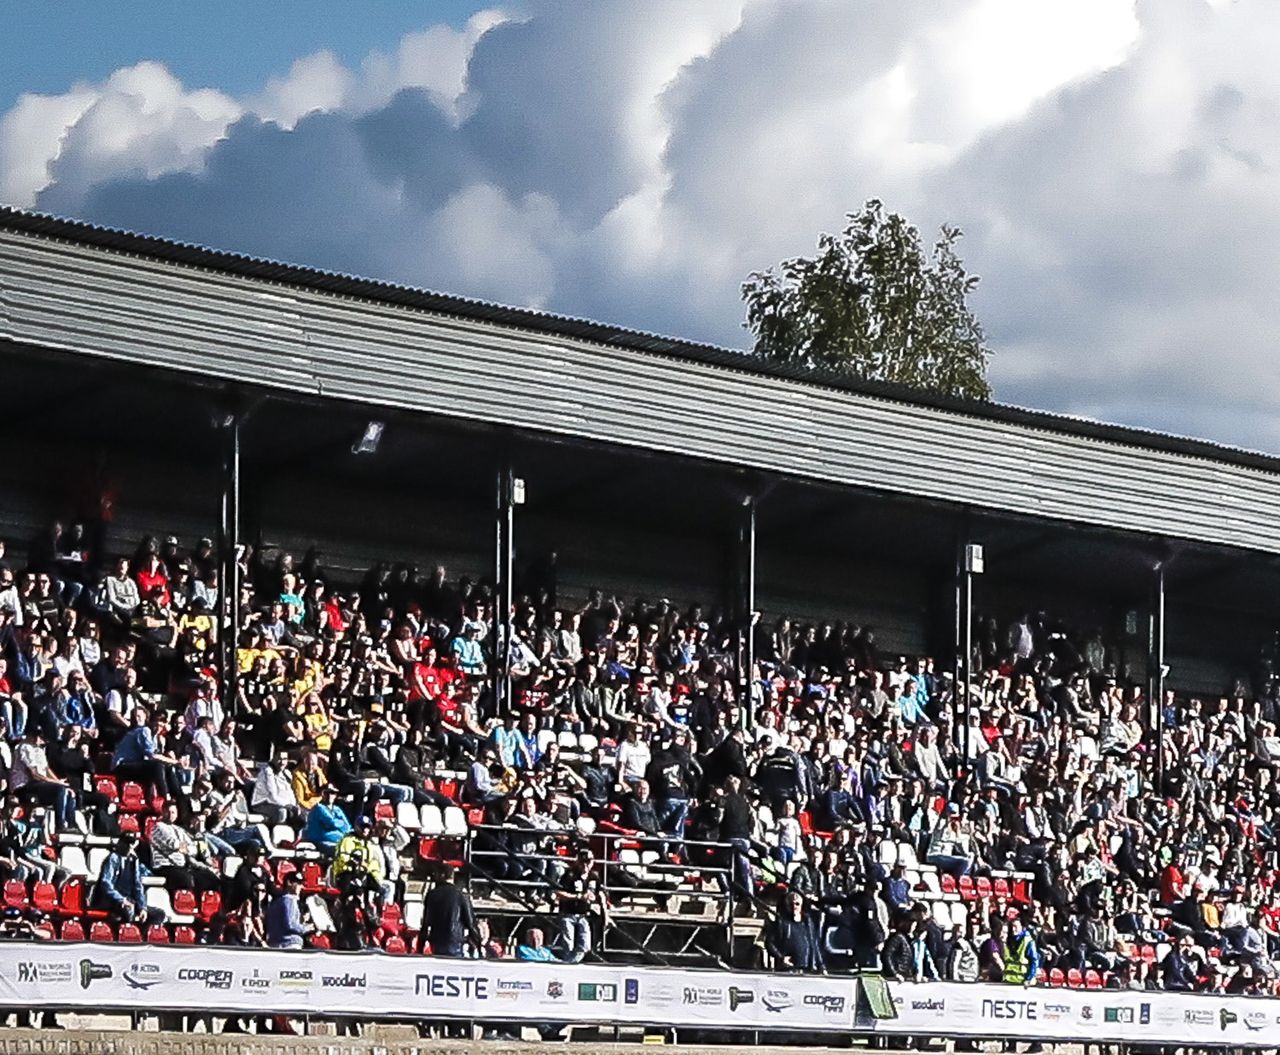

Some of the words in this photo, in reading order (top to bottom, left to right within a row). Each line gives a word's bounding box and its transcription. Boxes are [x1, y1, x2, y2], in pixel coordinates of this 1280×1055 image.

[178, 968, 233, 982] COOPER
[415, 974, 489, 999] NESTE
[803, 994, 846, 1006] COOPER
[981, 999, 1037, 1020] NESTE
